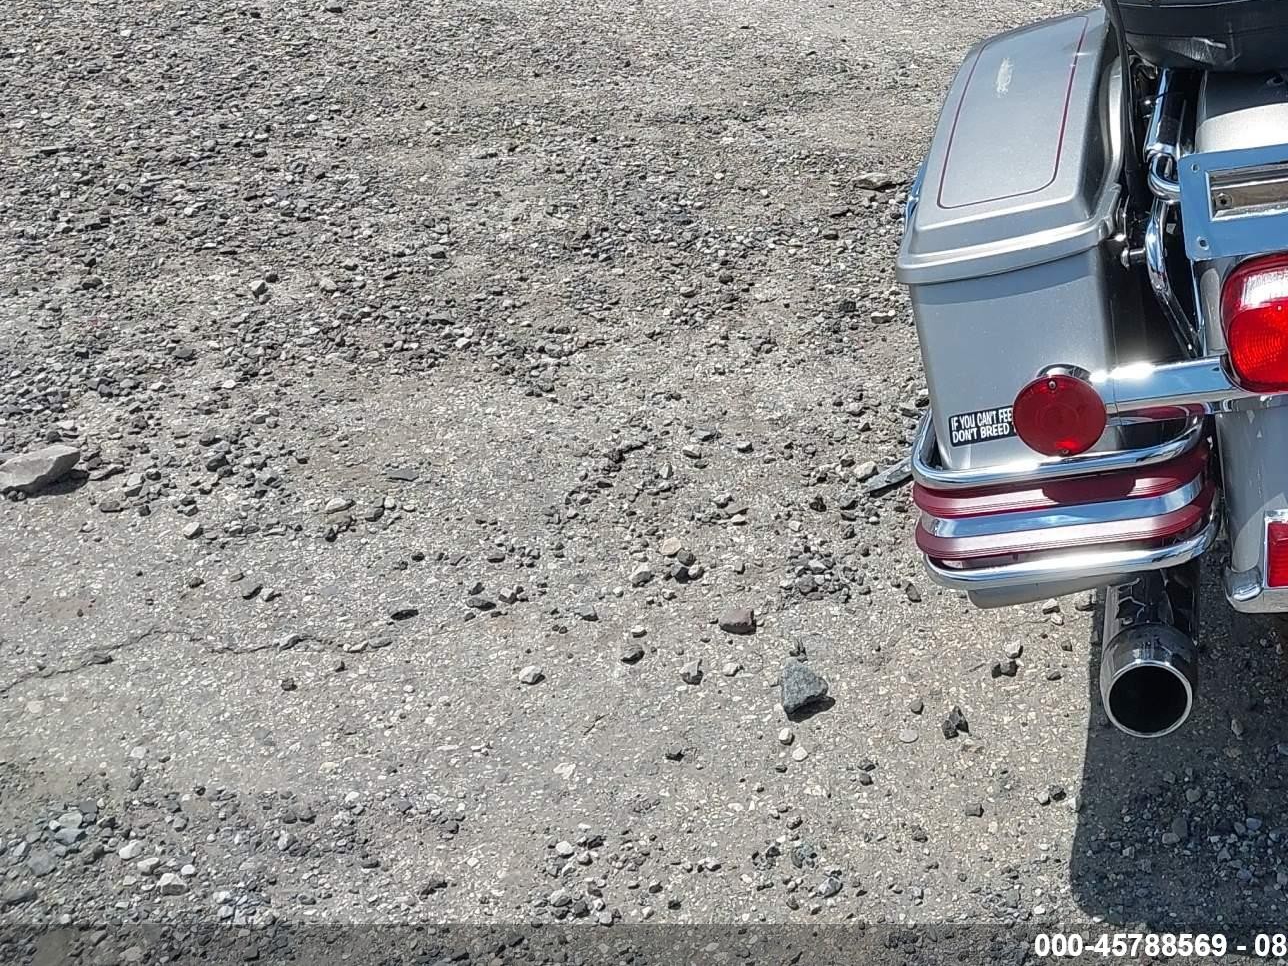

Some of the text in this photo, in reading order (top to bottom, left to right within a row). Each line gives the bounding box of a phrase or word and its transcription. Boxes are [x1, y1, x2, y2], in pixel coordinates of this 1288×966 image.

[950, 417, 959, 431] IF
[959, 413, 976, 429] YOU
[976, 410, 997, 427] CAN'T
[998, 407, 1013, 423] FEE
[952, 428, 978, 443] DON'T
[980, 423, 1010, 439] BREED
